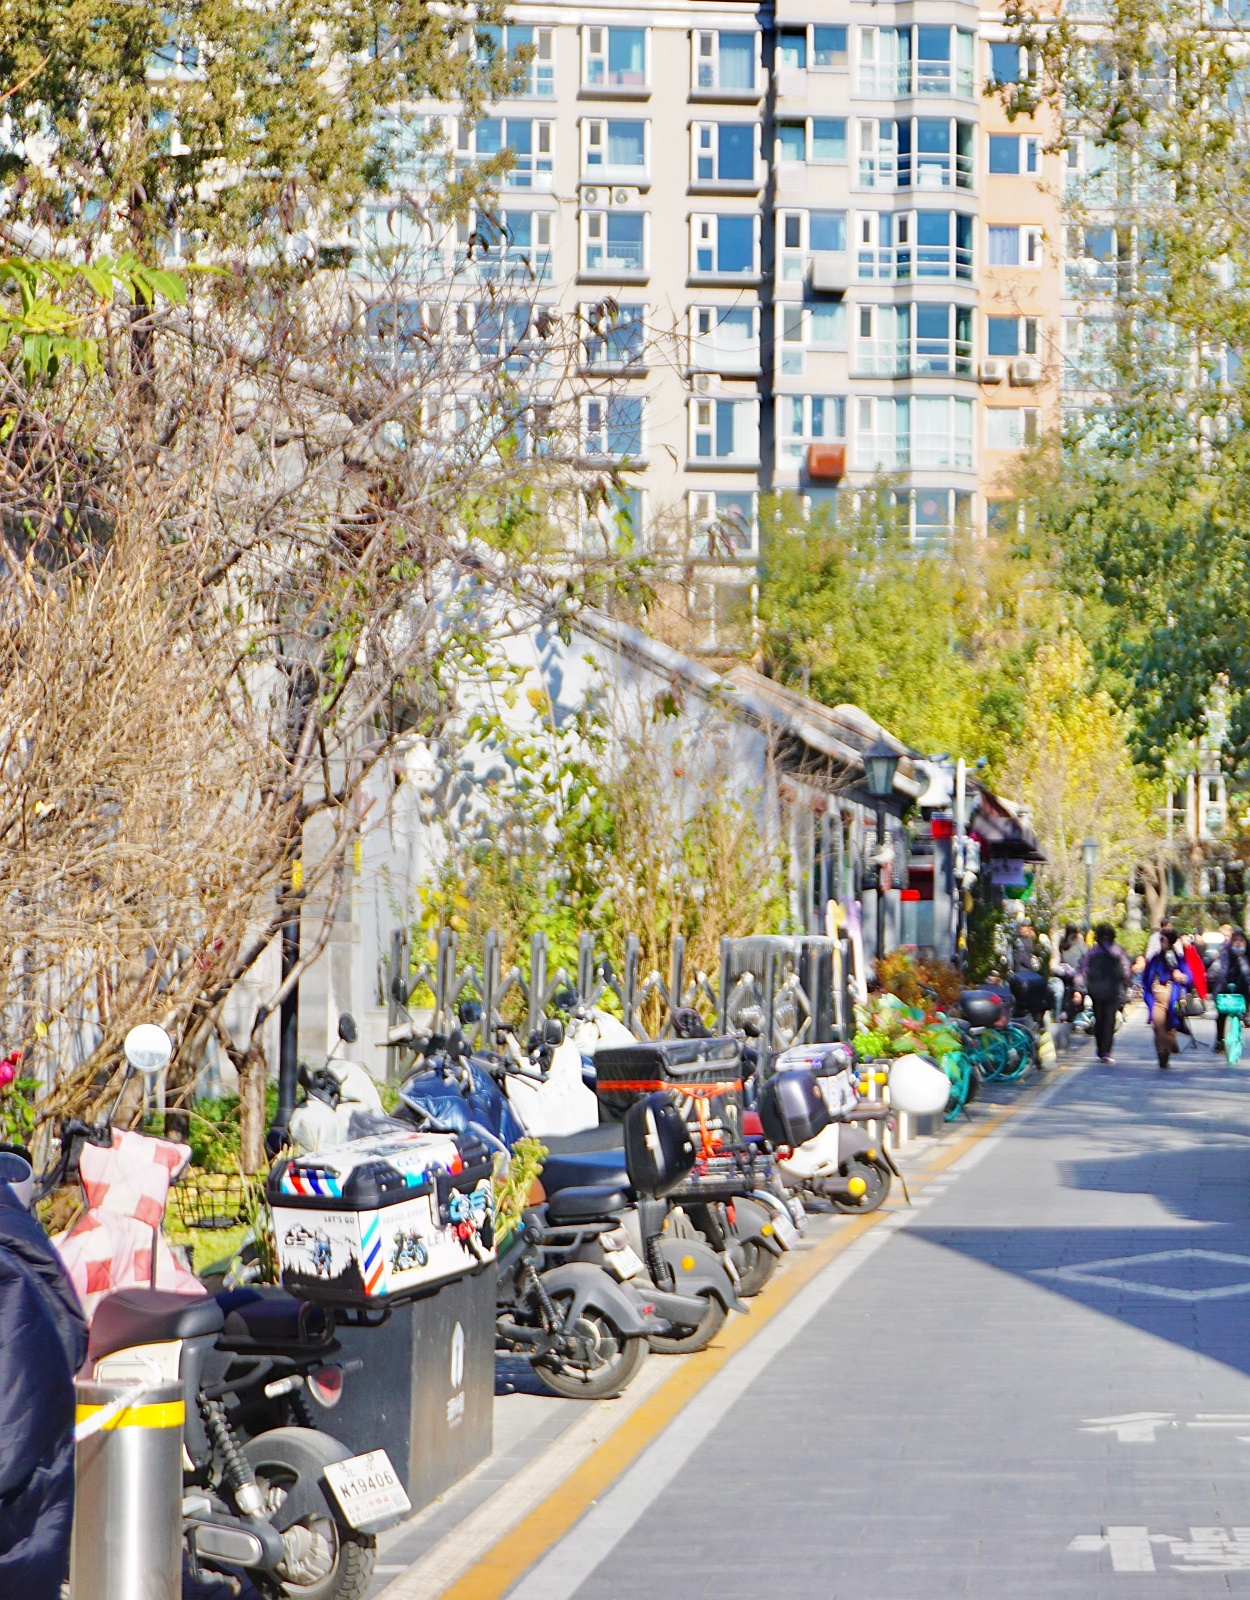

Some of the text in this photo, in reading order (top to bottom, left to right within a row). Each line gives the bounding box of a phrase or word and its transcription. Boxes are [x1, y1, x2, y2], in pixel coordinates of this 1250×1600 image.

[398, 1154, 421, 1168] GS
[324, 1215, 355, 1224] LET'S GO
[285, 1233, 307, 1246] GS
